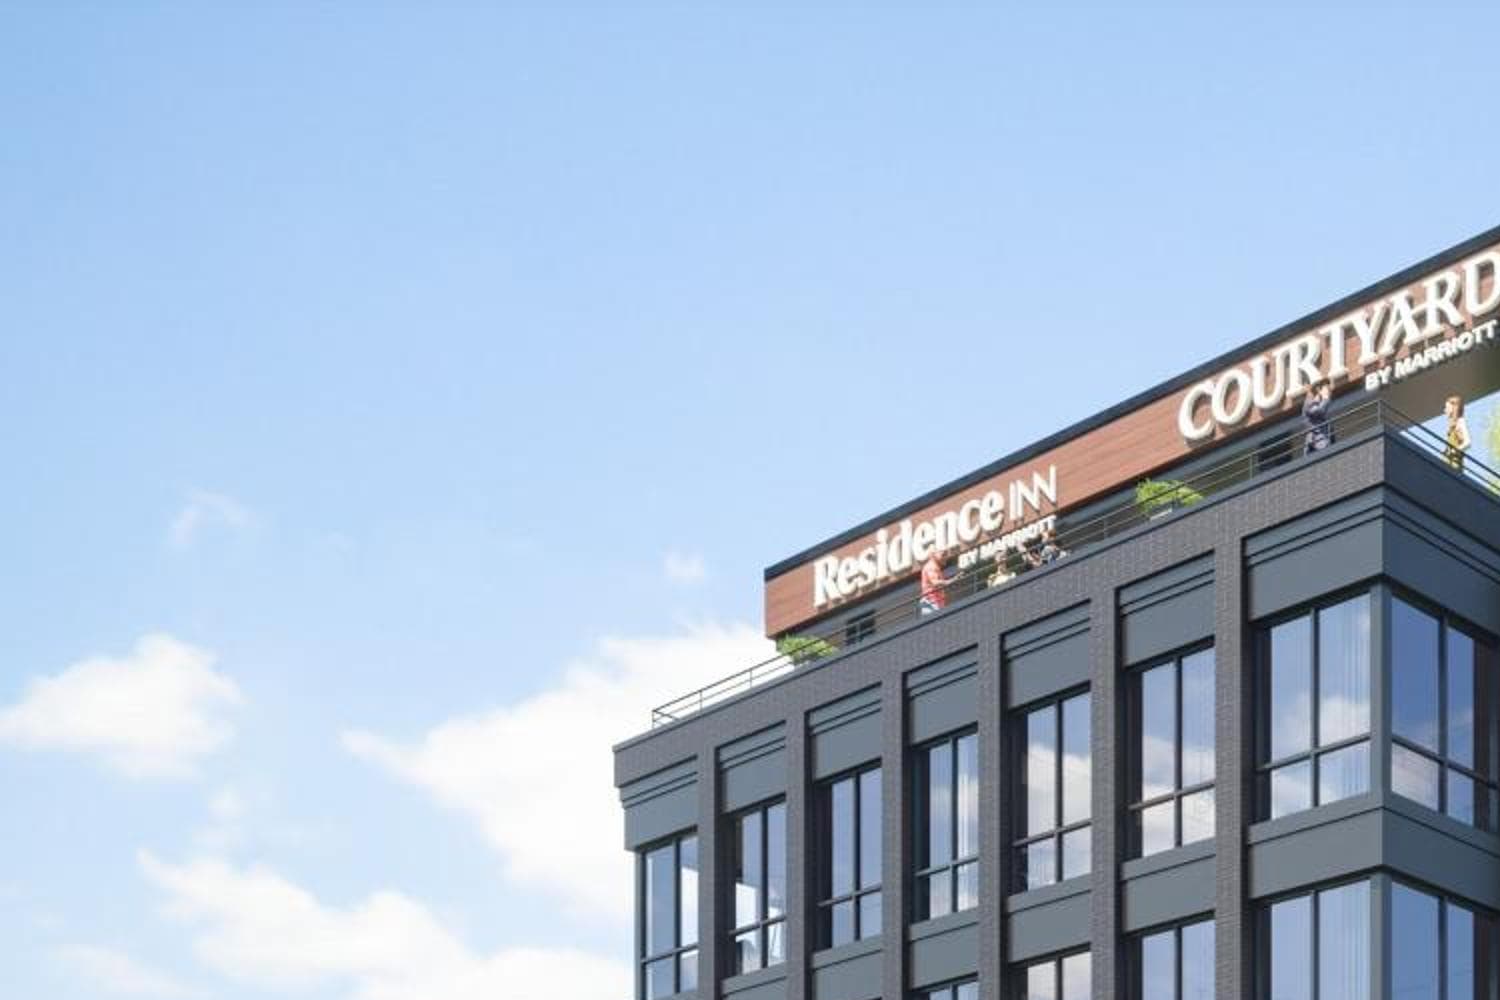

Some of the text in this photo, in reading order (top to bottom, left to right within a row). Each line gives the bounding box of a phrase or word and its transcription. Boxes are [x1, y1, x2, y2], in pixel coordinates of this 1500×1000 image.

[1365, 319, 1499, 391] BY MARRIOTT
[813, 465, 1057, 607] Residence INN
